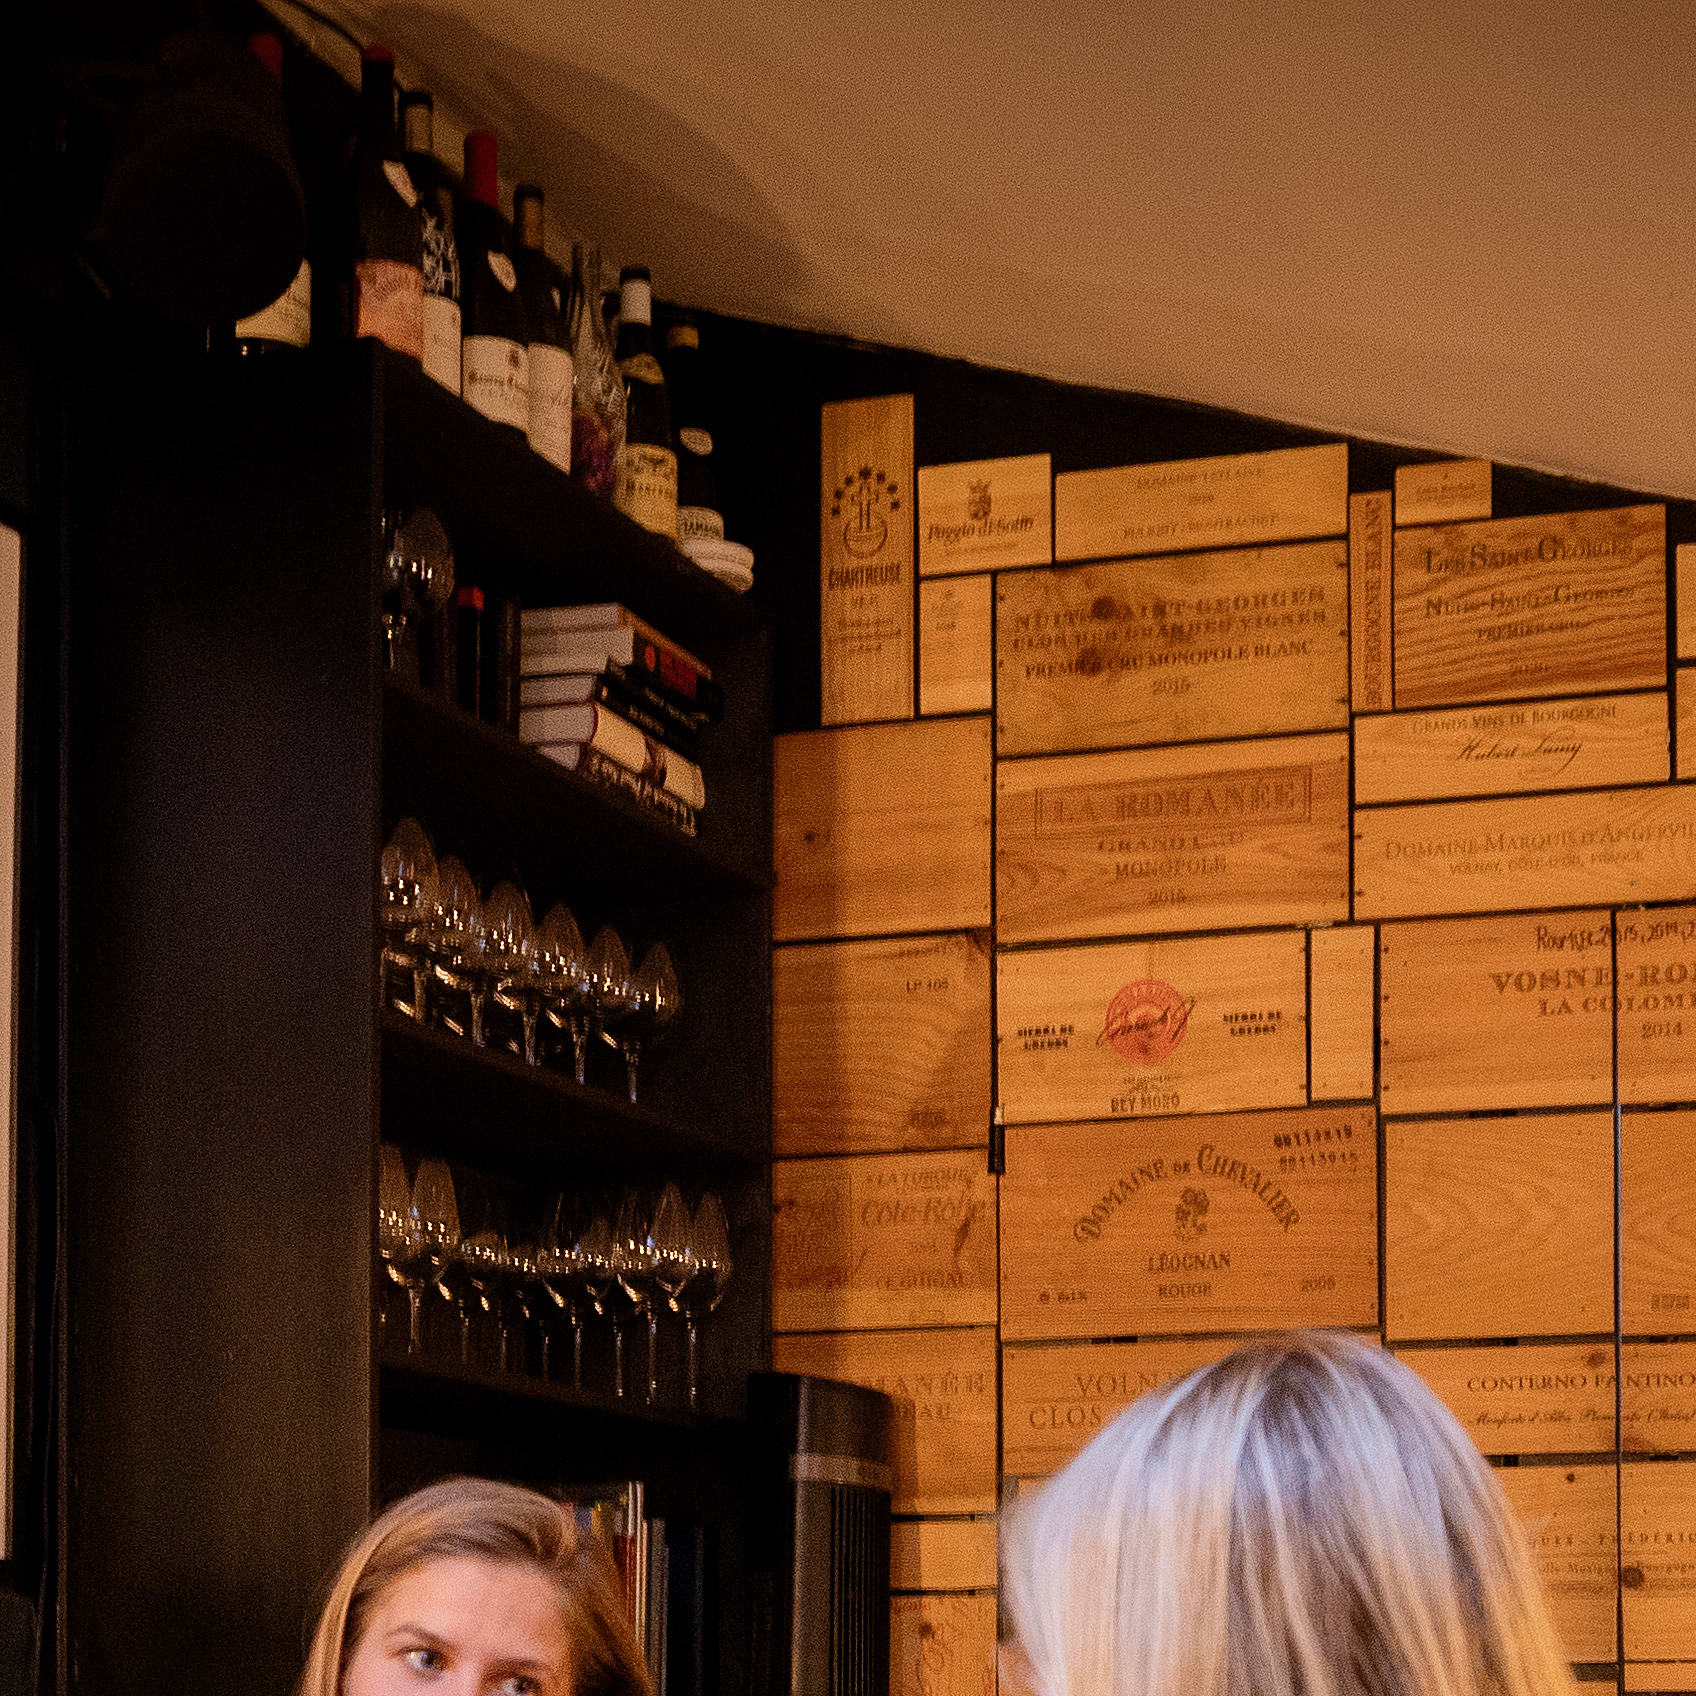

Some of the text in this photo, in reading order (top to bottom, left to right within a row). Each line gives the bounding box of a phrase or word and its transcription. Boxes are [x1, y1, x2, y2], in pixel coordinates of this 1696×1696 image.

[828, 561, 902, 591] CHARTREUSE
[1148, 643, 1250, 669] MONOPOLE
[1253, 638, 1314, 659] BLANC
[1532, 705, 1619, 725] BOURGOGNE
[1052, 776, 1297, 824] LA ROMANÉE
[1114, 854, 1229, 881] MONOPOLE
[1536, 998, 1574, 1018] LA
[1641, 1021, 1684, 1039] 2014
[1072, 1158, 1167, 1244] DOMAINE
[1197, 1143, 1301, 1233] CHEVALIER
[1147, 1250, 1232, 1274] LÉOGNAN
[1466, 1373, 1588, 1394] CONTERNO
[1027, 1405, 1105, 1431] CLOS
